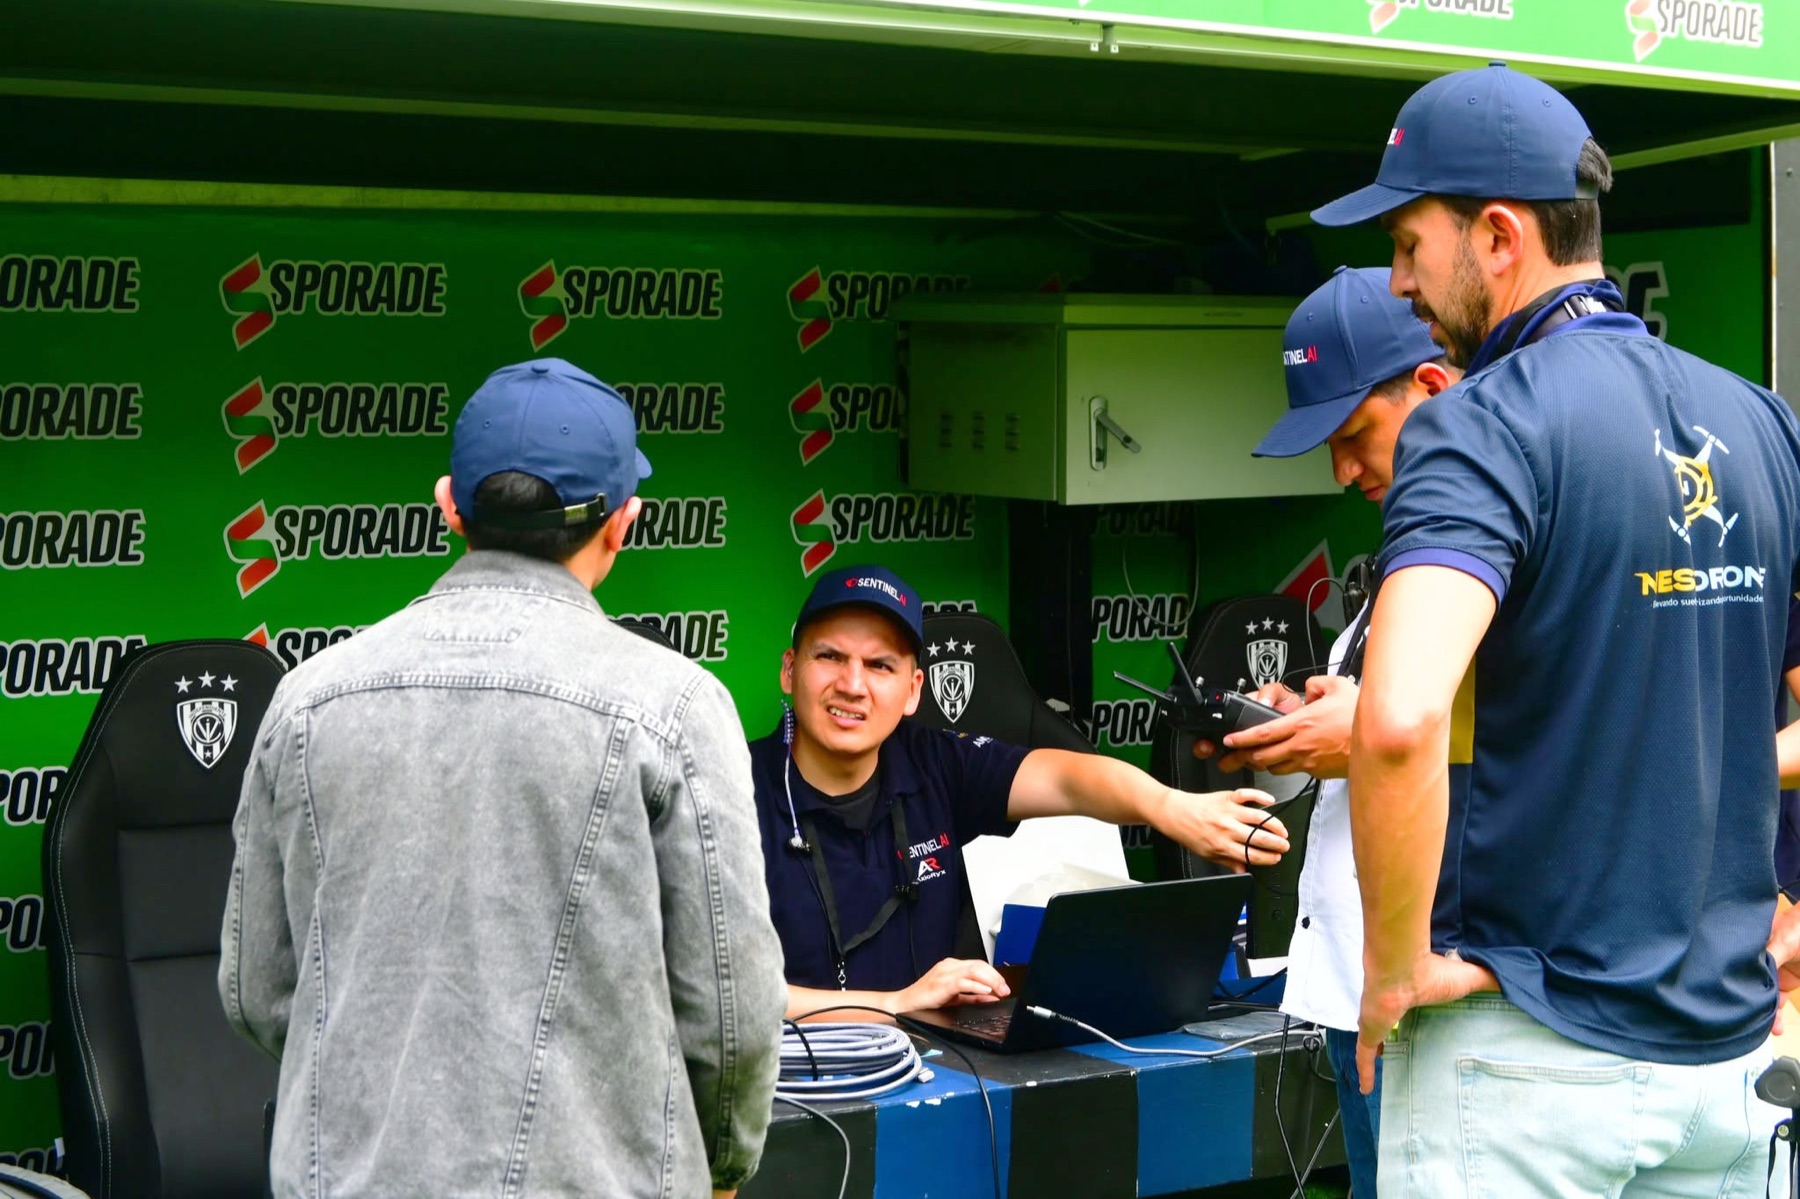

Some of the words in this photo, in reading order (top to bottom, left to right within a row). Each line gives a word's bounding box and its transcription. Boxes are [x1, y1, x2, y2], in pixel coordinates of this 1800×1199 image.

[1657, 0, 1760, 42] SPORADE
[270, 263, 446, 316] SPORADE
[564, 269, 722, 318] SPORADE
[0, 385, 140, 437] ORADE
[273, 384, 448, 435] SPORADE
[830, 385, 900, 432] SPO
[0, 512, 142, 566] ORADE
[274, 505, 449, 556] SPORADE
[831, 494, 973, 542] SPORADE
